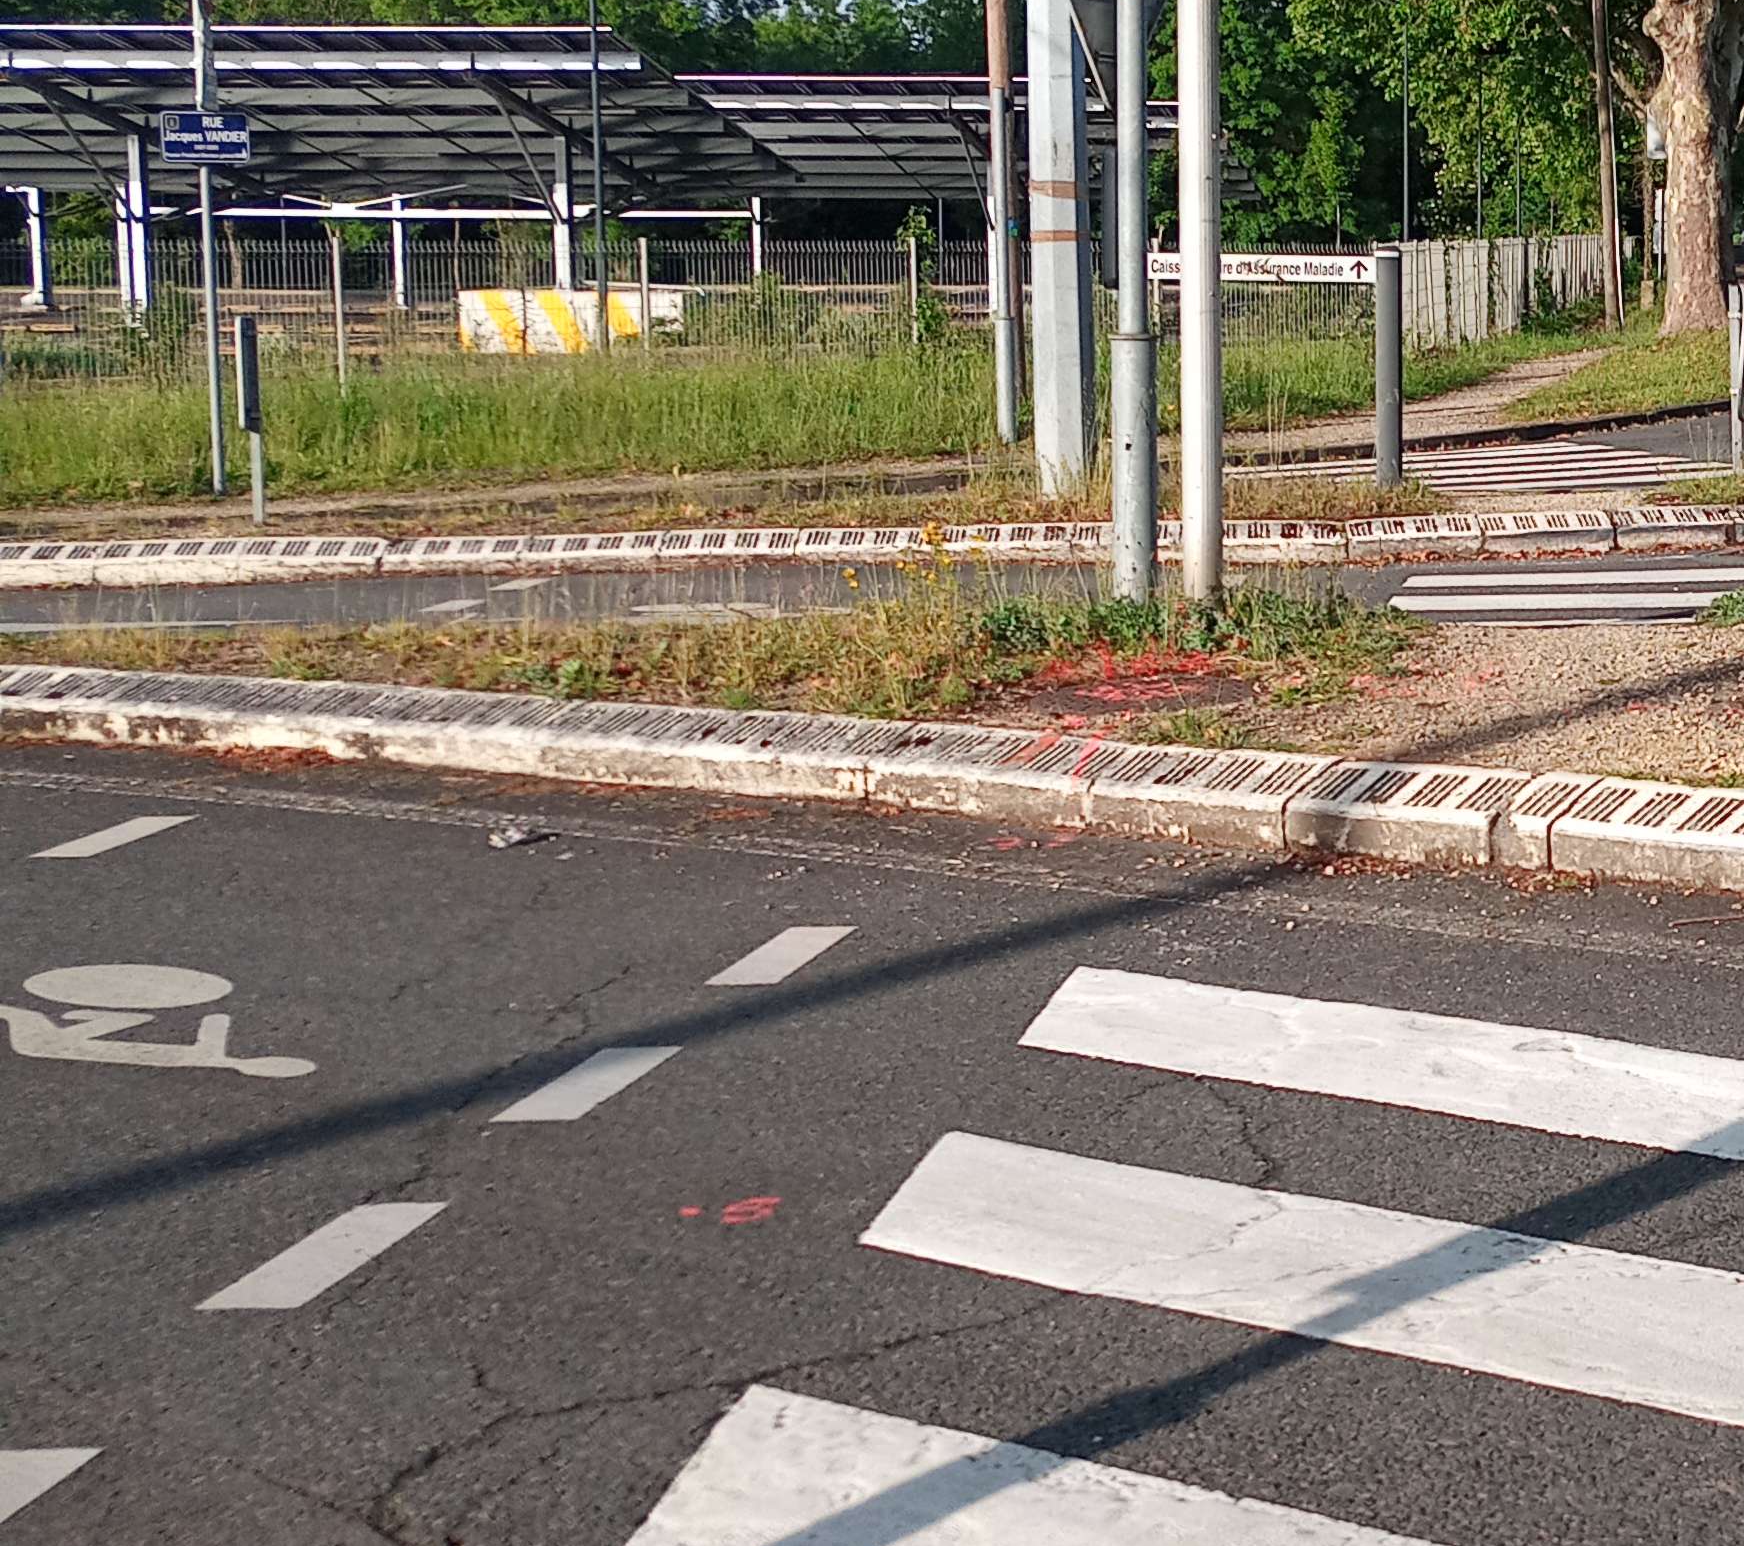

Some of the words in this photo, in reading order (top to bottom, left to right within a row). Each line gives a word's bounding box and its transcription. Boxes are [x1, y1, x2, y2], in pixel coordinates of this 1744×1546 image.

[201, 116, 225, 128] RUE
[163, 130, 203, 144] Jacques
[204, 130, 248, 143] VANDIER
[1151, 259, 1180, 273] Caiss
[1304, 261, 1344, 276] Maladie
